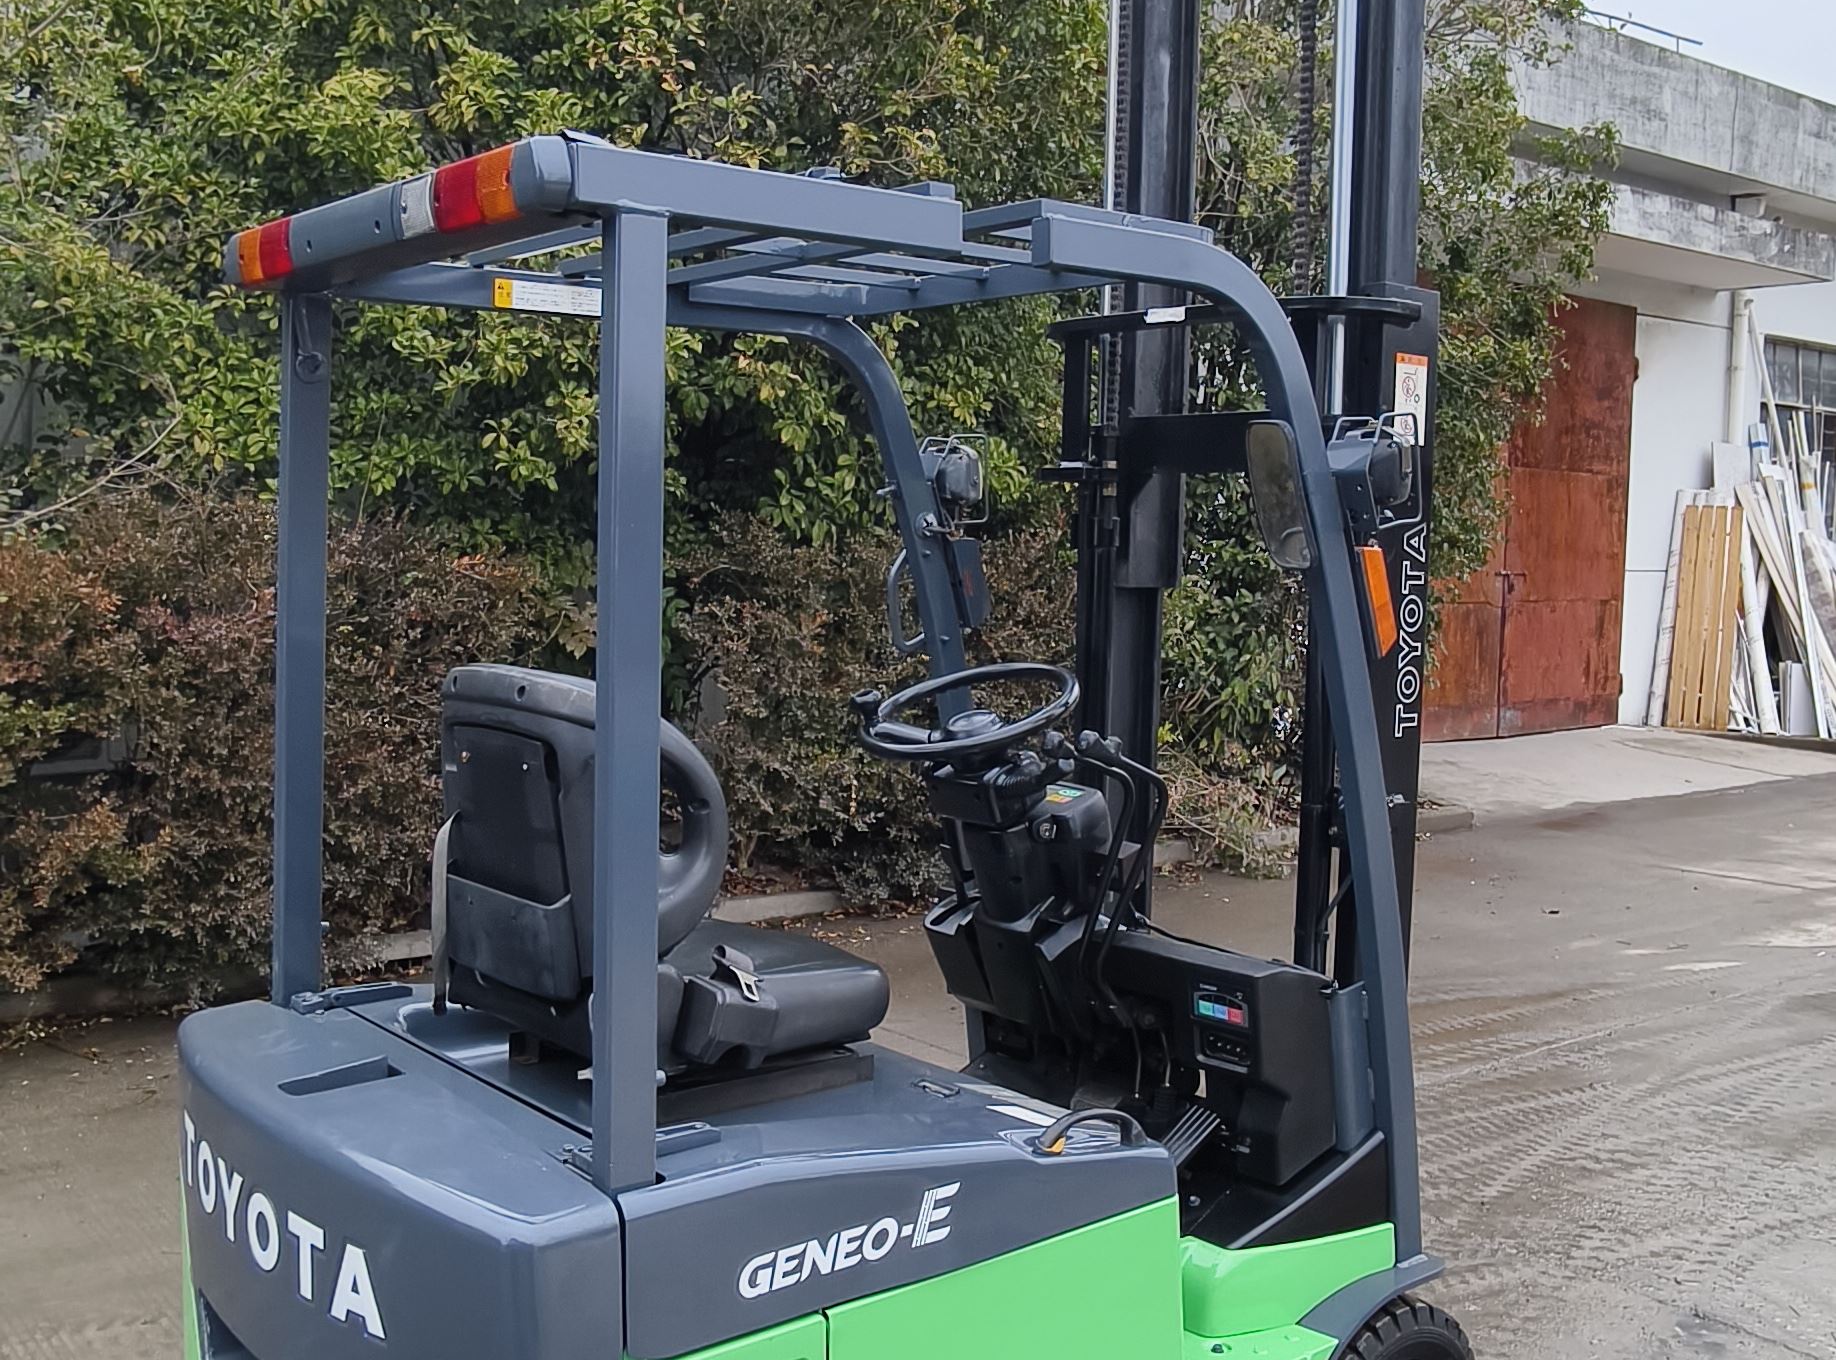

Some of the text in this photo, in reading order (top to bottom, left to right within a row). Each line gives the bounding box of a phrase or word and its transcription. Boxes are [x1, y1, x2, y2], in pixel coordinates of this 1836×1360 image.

[1395, 523, 1427, 737] TOYOTA
[184, 1108, 387, 1340] TOYOTA
[738, 1181, 961, 1299] GENEO-E
